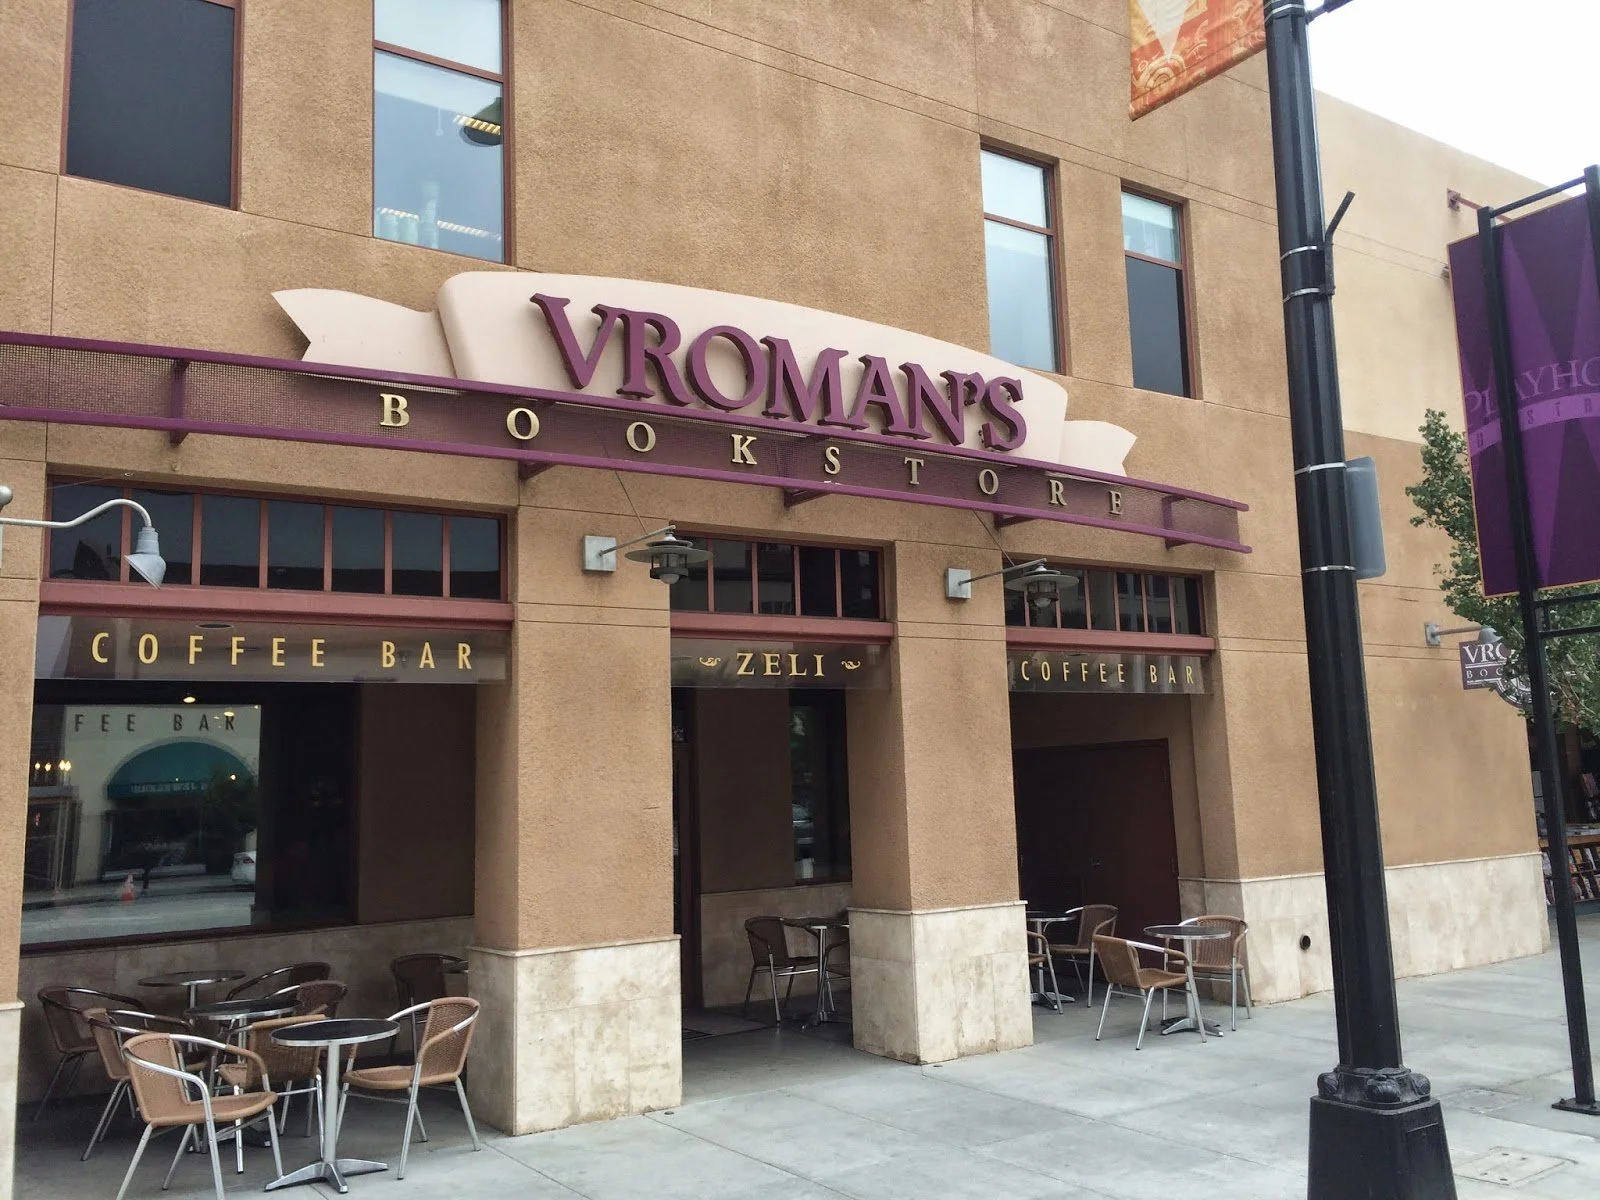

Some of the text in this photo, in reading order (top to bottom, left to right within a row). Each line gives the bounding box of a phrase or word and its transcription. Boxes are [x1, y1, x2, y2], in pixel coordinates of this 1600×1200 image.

[529, 292, 1028, 451] VROMAN'S
[379, 392, 1124, 516] BOOKSTORE
[91, 632, 473, 670] COFFEE BAR
[735, 651, 826, 678] ZELI
[1462, 643, 1512, 663] VRO
[1021, 660, 1195, 685] COFFEE BAR
[173, 713, 235, 732] BAR
